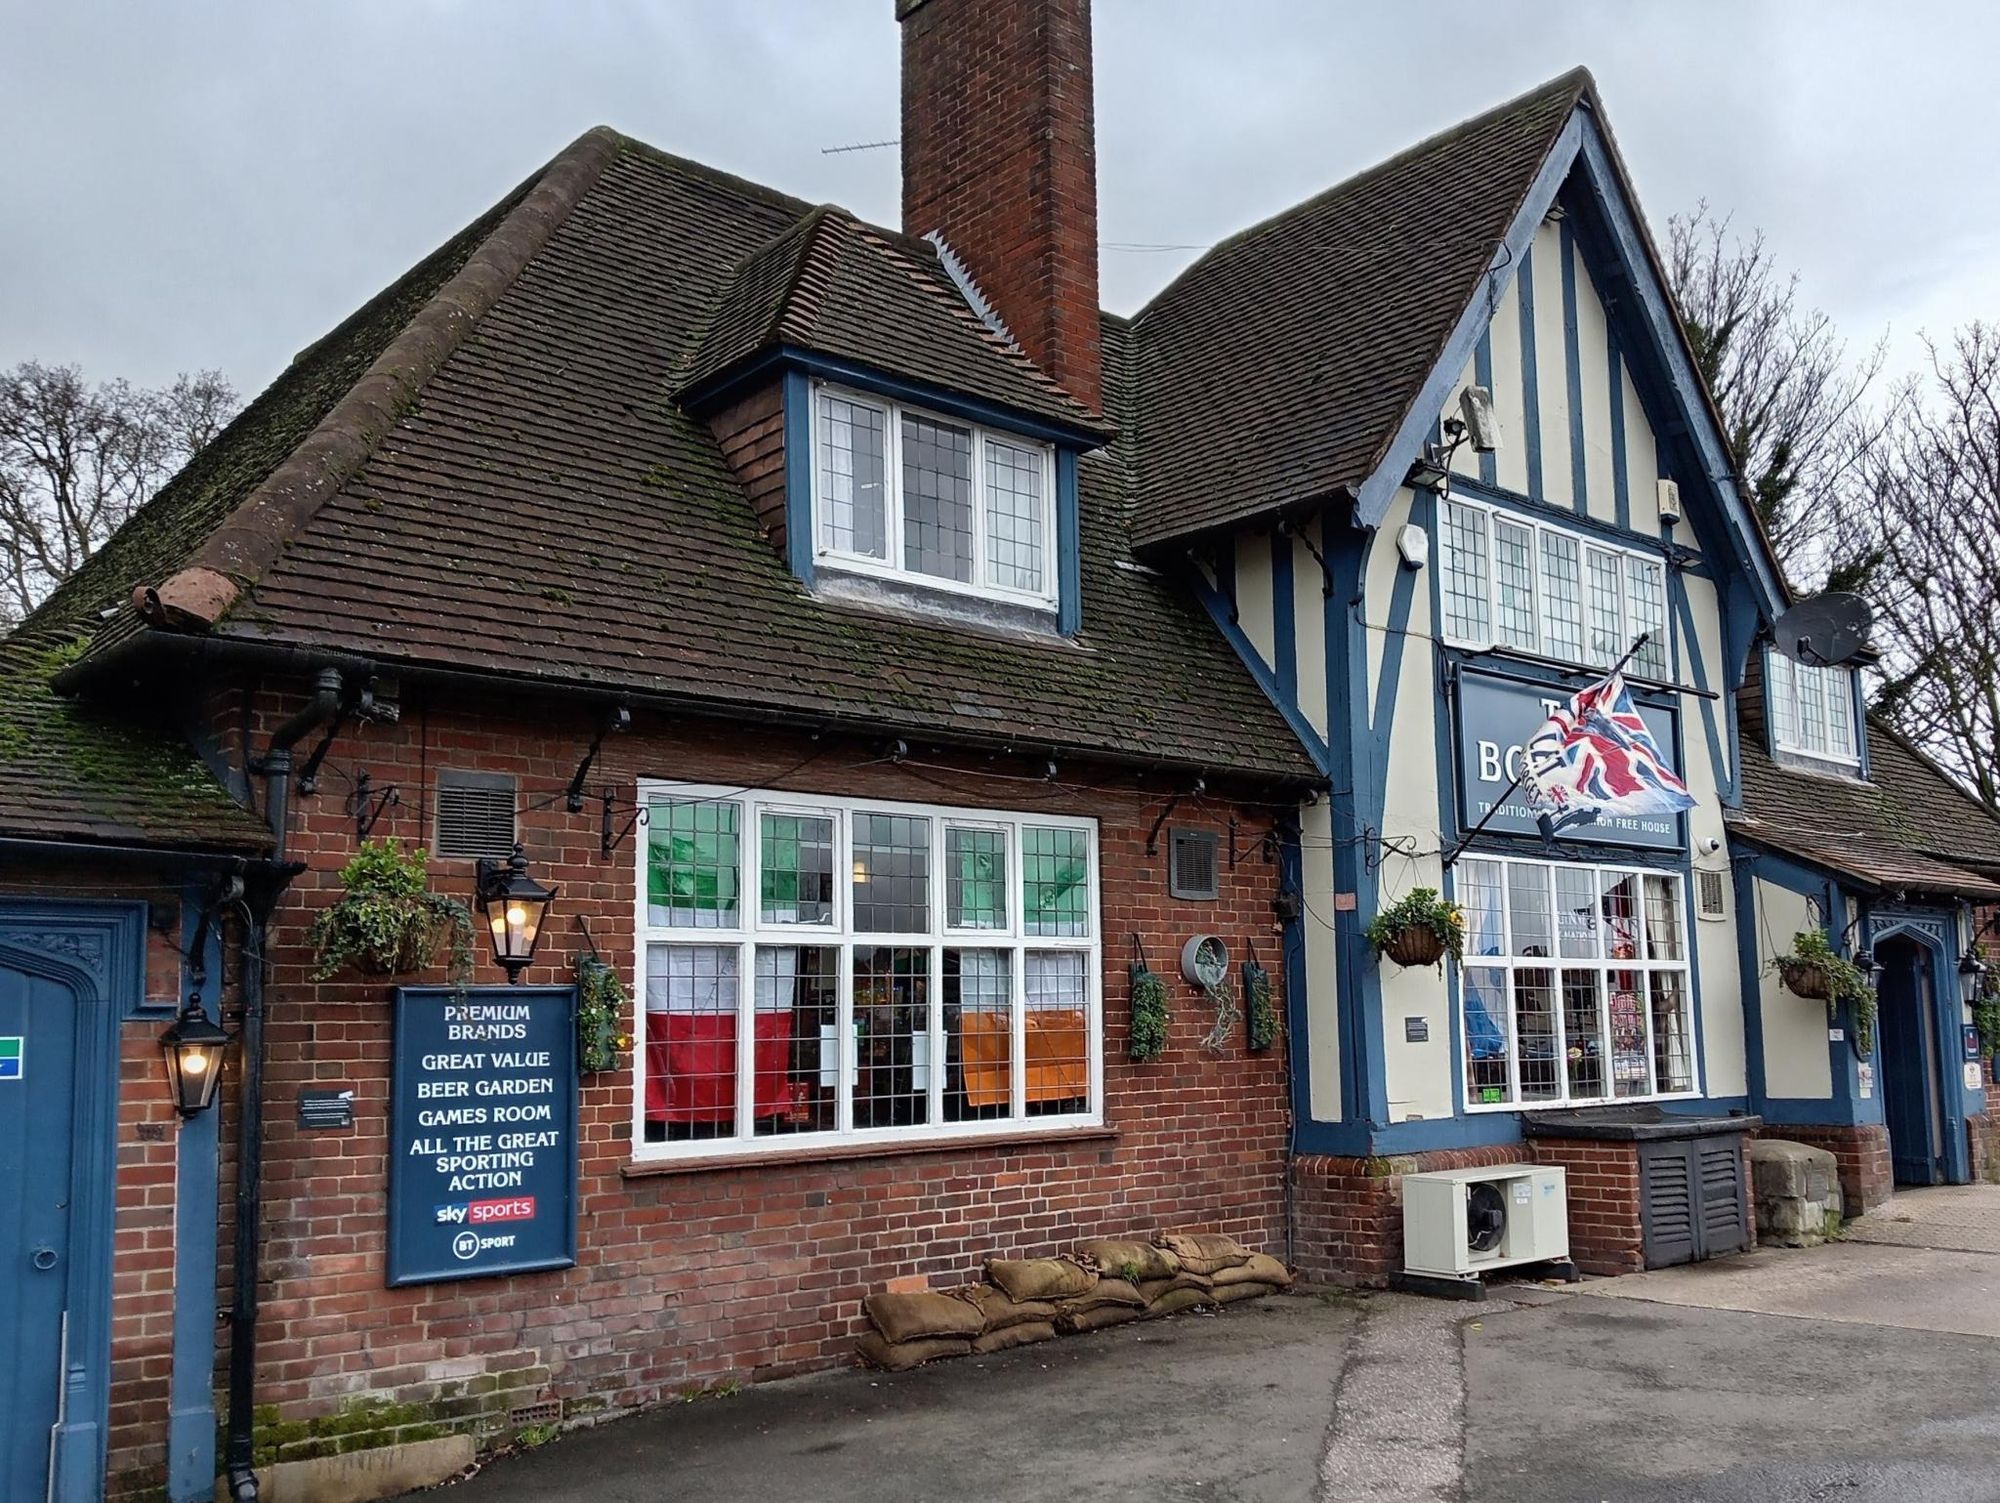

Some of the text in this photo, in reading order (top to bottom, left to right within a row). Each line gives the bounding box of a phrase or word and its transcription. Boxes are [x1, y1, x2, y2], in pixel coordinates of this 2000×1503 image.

[1616, 817, 1639, 831] FREE
[1641, 820, 1671, 834] HOUSE
[445, 1006, 530, 1020] PREMIUM
[449, 1024, 526, 1040] BRANDS
[422, 1052, 550, 1070] GREAT VALUE
[418, 1079, 552, 1098] BEER GARDEN
[419, 1105, 551, 1126] GAMES ROOM
[410, 1131, 559, 1155] ALL THE GREAT
[436, 1151, 533, 1173] SPORTING
[449, 1170, 521, 1191] ACTION
[437, 1201, 530, 1223] sky sports
[458, 1235, 516, 1252] BT SPORT
